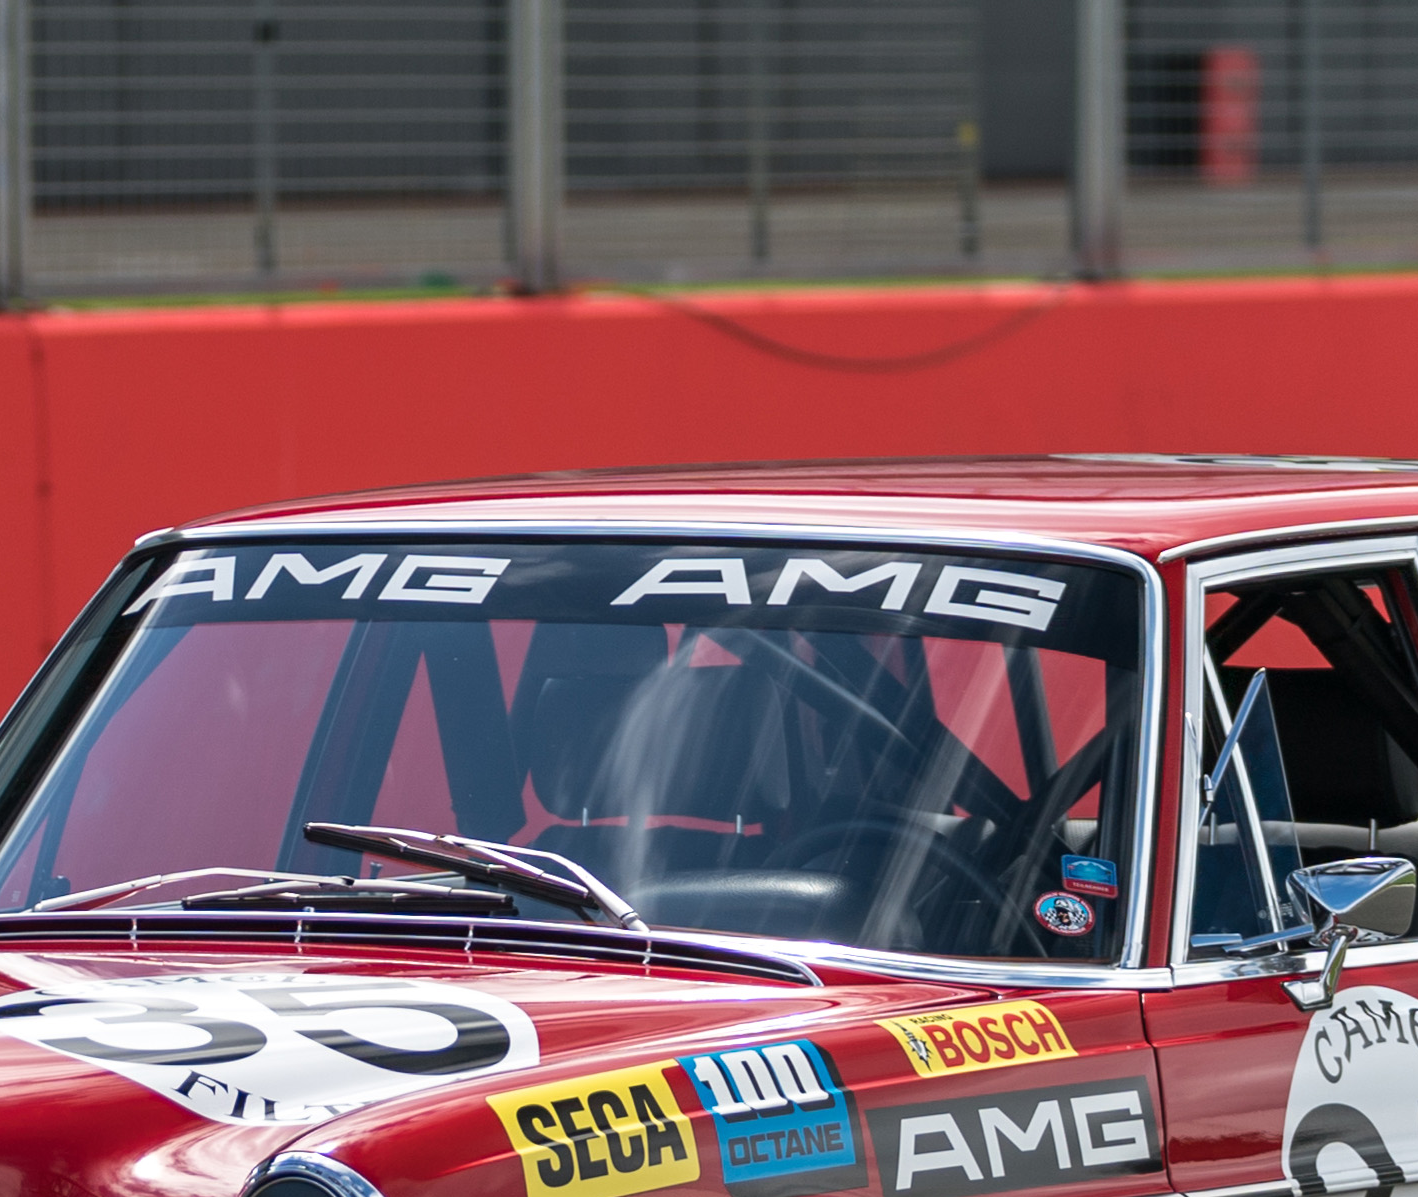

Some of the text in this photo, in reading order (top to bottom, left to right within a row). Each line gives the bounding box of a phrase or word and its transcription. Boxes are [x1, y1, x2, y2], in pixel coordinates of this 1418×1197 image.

[122, 550, 1067, 632] AMG AMG
[909, 1013, 954, 1025] RACING
[921, 1008, 1067, 1069] BOSCH
[171, 1069, 373, 1121] FILT
[692, 1043, 831, 1123] 100
[515, 1083, 689, 1189] SECA
[728, 1122, 845, 1168] OCTANE
[894, 1090, 1152, 1191] AMG
